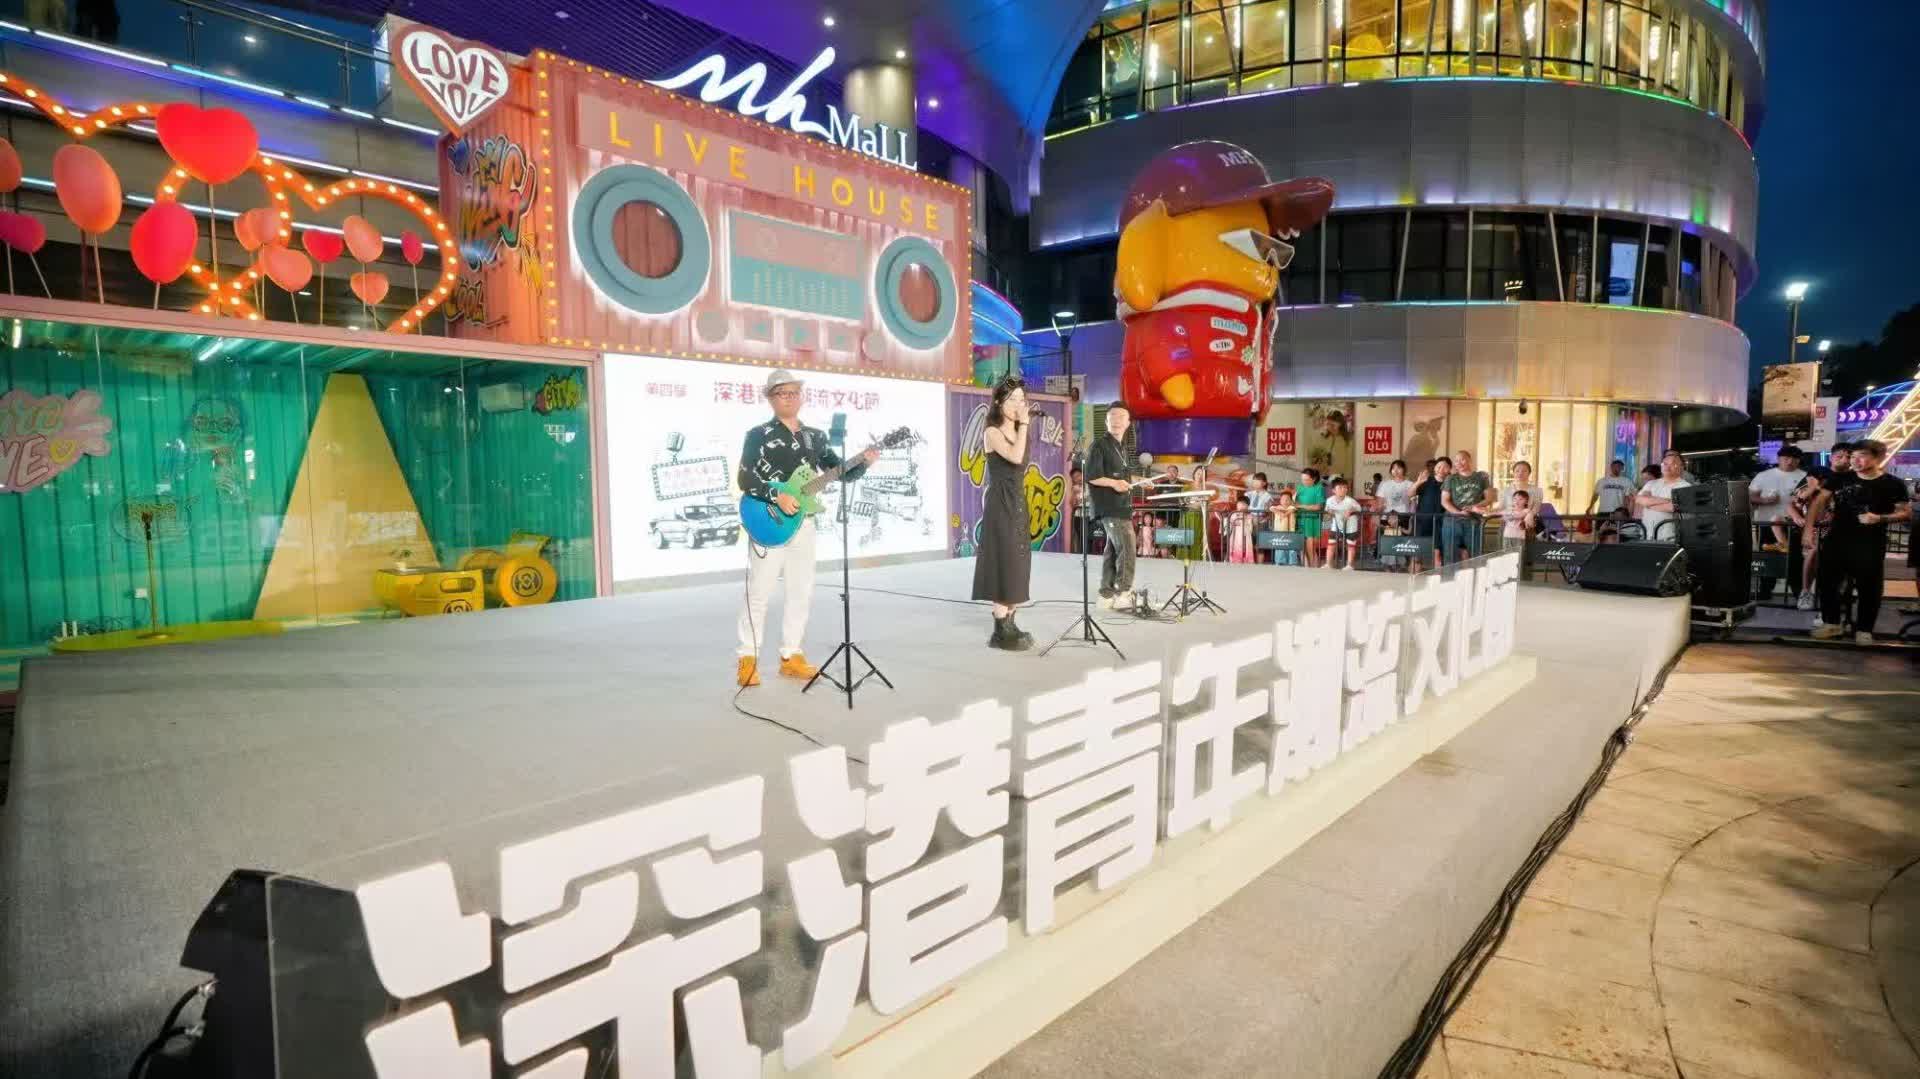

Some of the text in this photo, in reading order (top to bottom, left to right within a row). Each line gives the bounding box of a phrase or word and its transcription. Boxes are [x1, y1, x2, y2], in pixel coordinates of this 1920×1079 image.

[410, 39, 500, 96] LOVE
[422, 78, 494, 119] YOU
[609, 111, 941, 232] LIVE HOUSE
[1270, 431, 1291, 441] UNI
[1367, 429, 1388, 440] UNI
[1270, 442, 1293, 453] QLO
[1367, 441, 1389, 453] QLO
